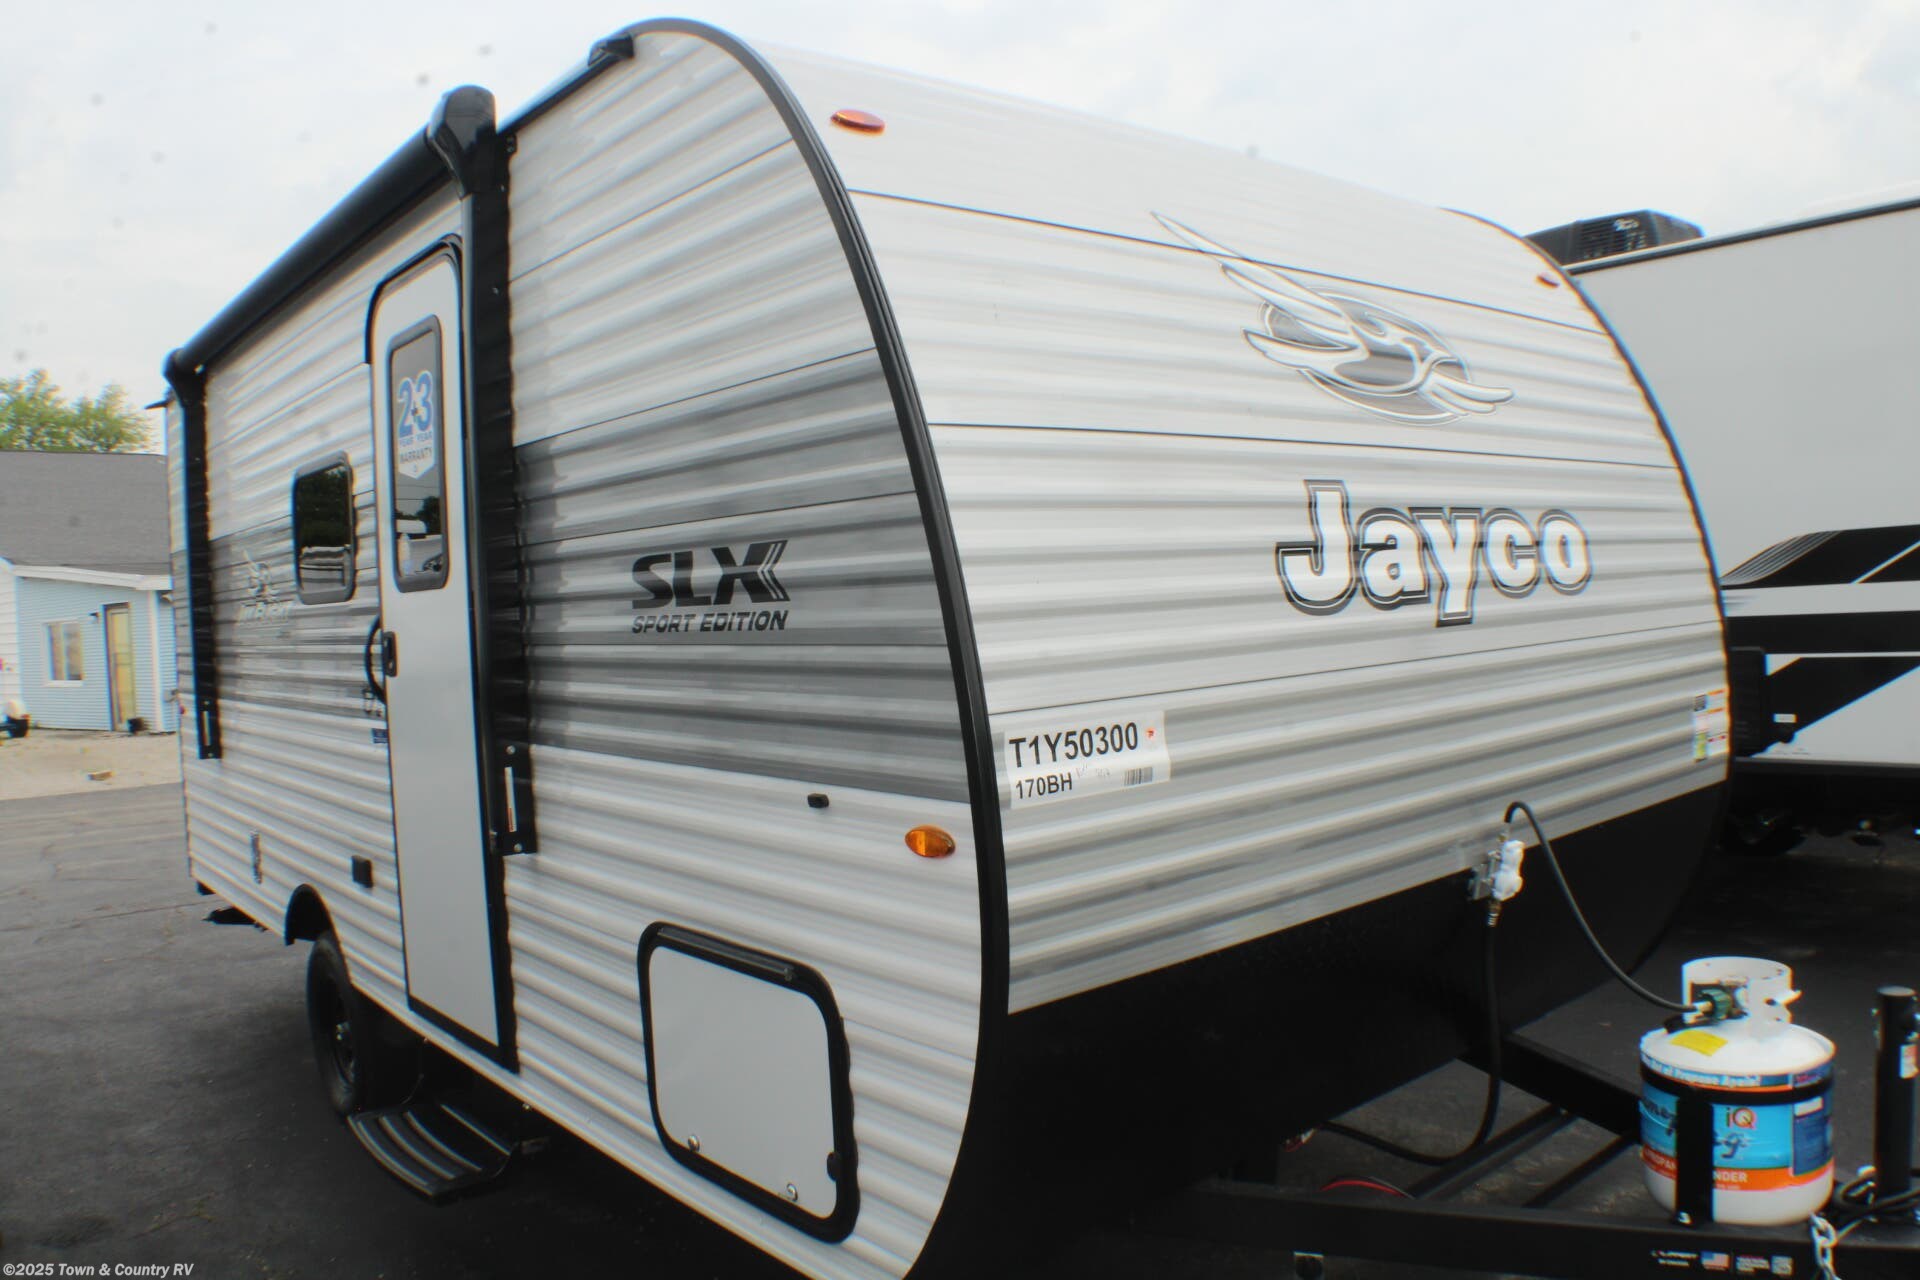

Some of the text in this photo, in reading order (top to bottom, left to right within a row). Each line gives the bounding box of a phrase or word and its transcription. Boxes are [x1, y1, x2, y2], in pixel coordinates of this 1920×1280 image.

[1275, 479, 1592, 627] Jayco
[632, 539, 790, 609] SLX
[632, 610, 789, 633] SPORT EDITION
[1008, 721, 1138, 768] T1Y50300
[1015, 772, 1073, 800] 170BH
[1726, 1107, 1757, 1130] iQ
